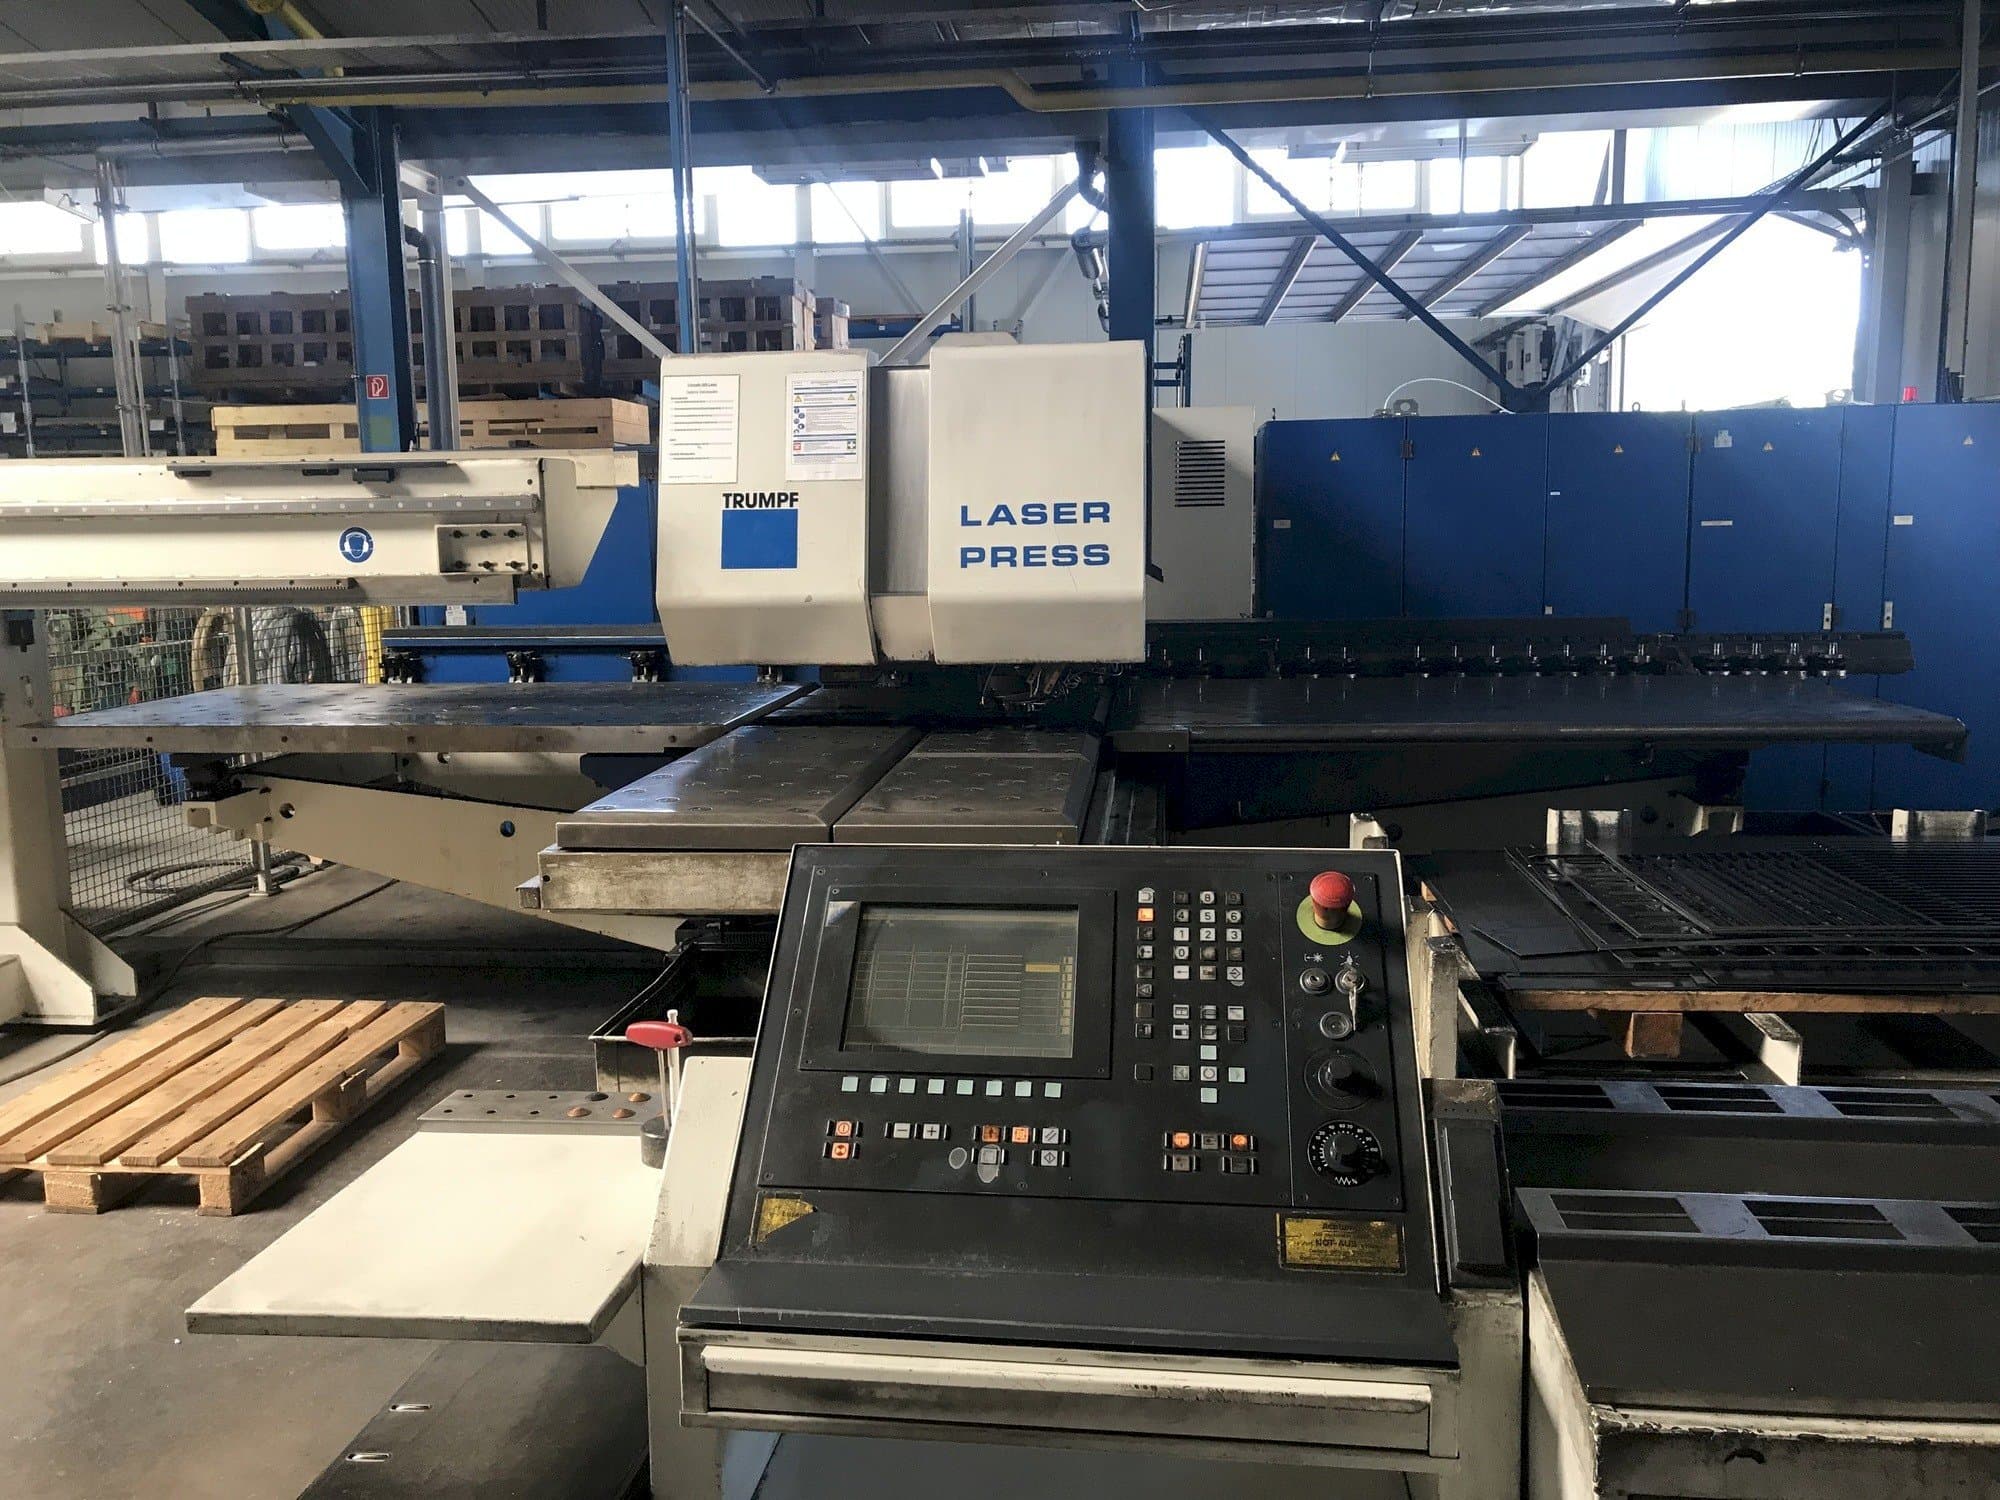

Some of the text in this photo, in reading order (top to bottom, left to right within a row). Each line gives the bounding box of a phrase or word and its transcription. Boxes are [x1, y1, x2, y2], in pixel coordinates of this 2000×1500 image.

[722, 492, 799, 508] TRUMPF
[960, 501, 1111, 527] LASER
[960, 543, 1111, 569] PRESS
[1204, 893, 1211, 902] 8
[1204, 911, 1211, 920] 5
[1230, 912, 1238, 921] 6
[1204, 930, 1211, 939] 2
[1231, 930, 1238, 940] 3
[1178, 948, 1185, 957] 0
